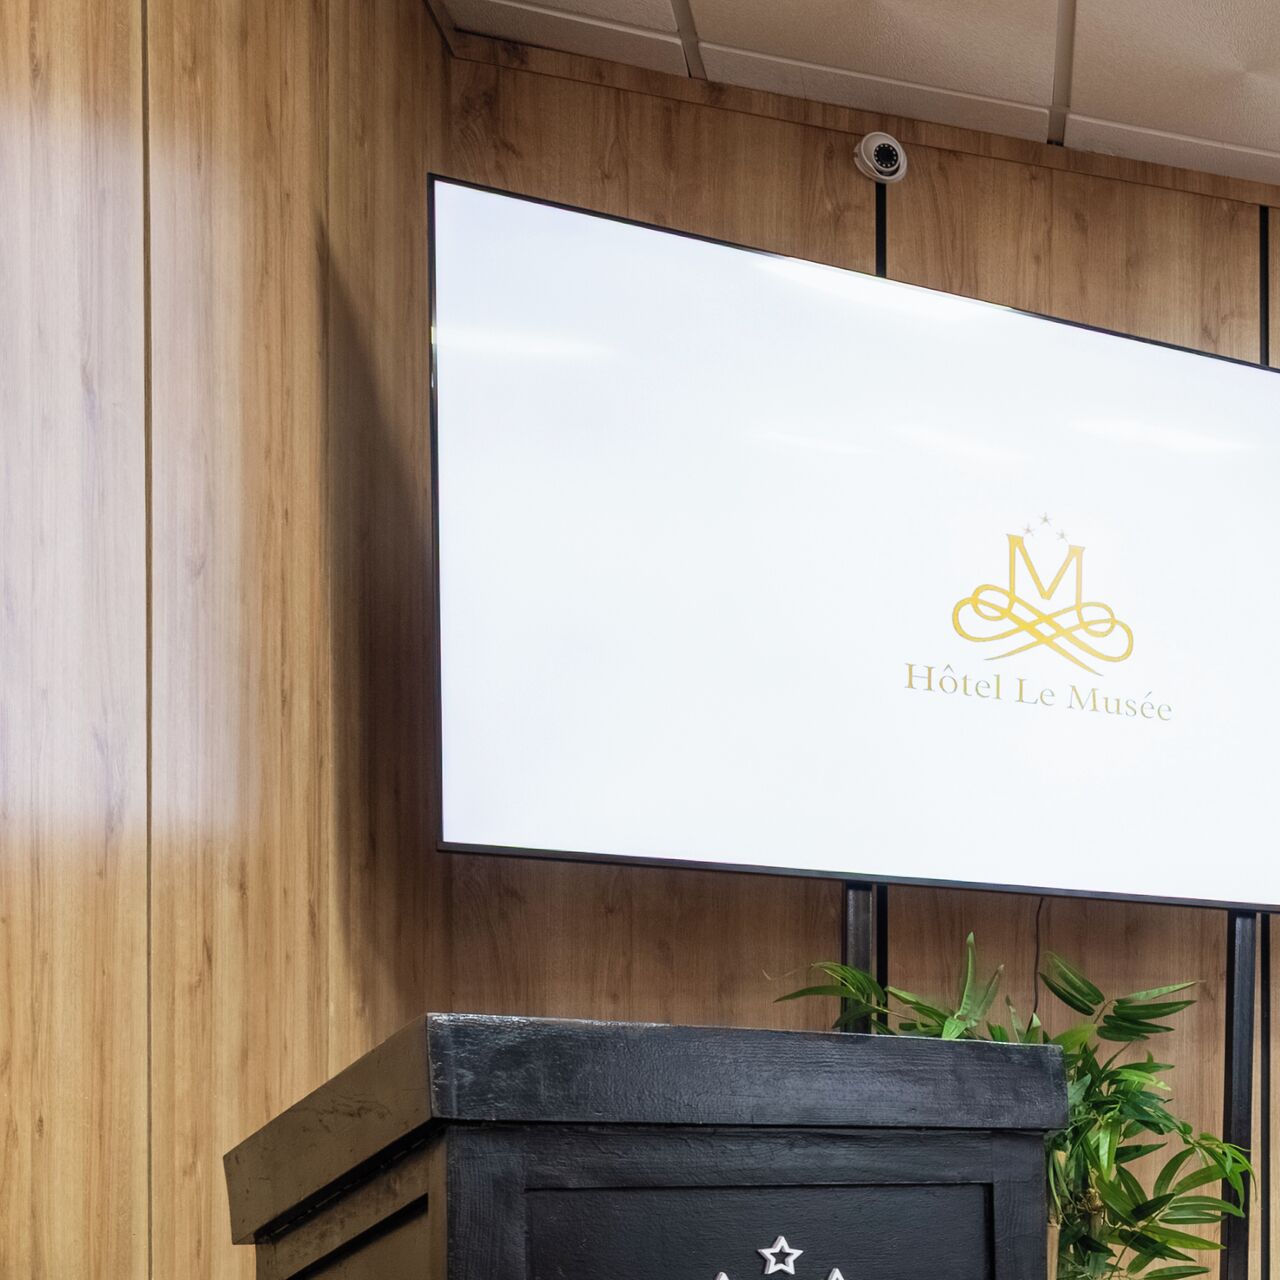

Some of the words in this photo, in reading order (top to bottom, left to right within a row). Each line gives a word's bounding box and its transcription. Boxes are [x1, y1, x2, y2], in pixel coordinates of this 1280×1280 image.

[904, 662, 1002, 701] Hôtel
[1015, 677, 1056, 707] Le
[1067, 684, 1173, 722] Musée
